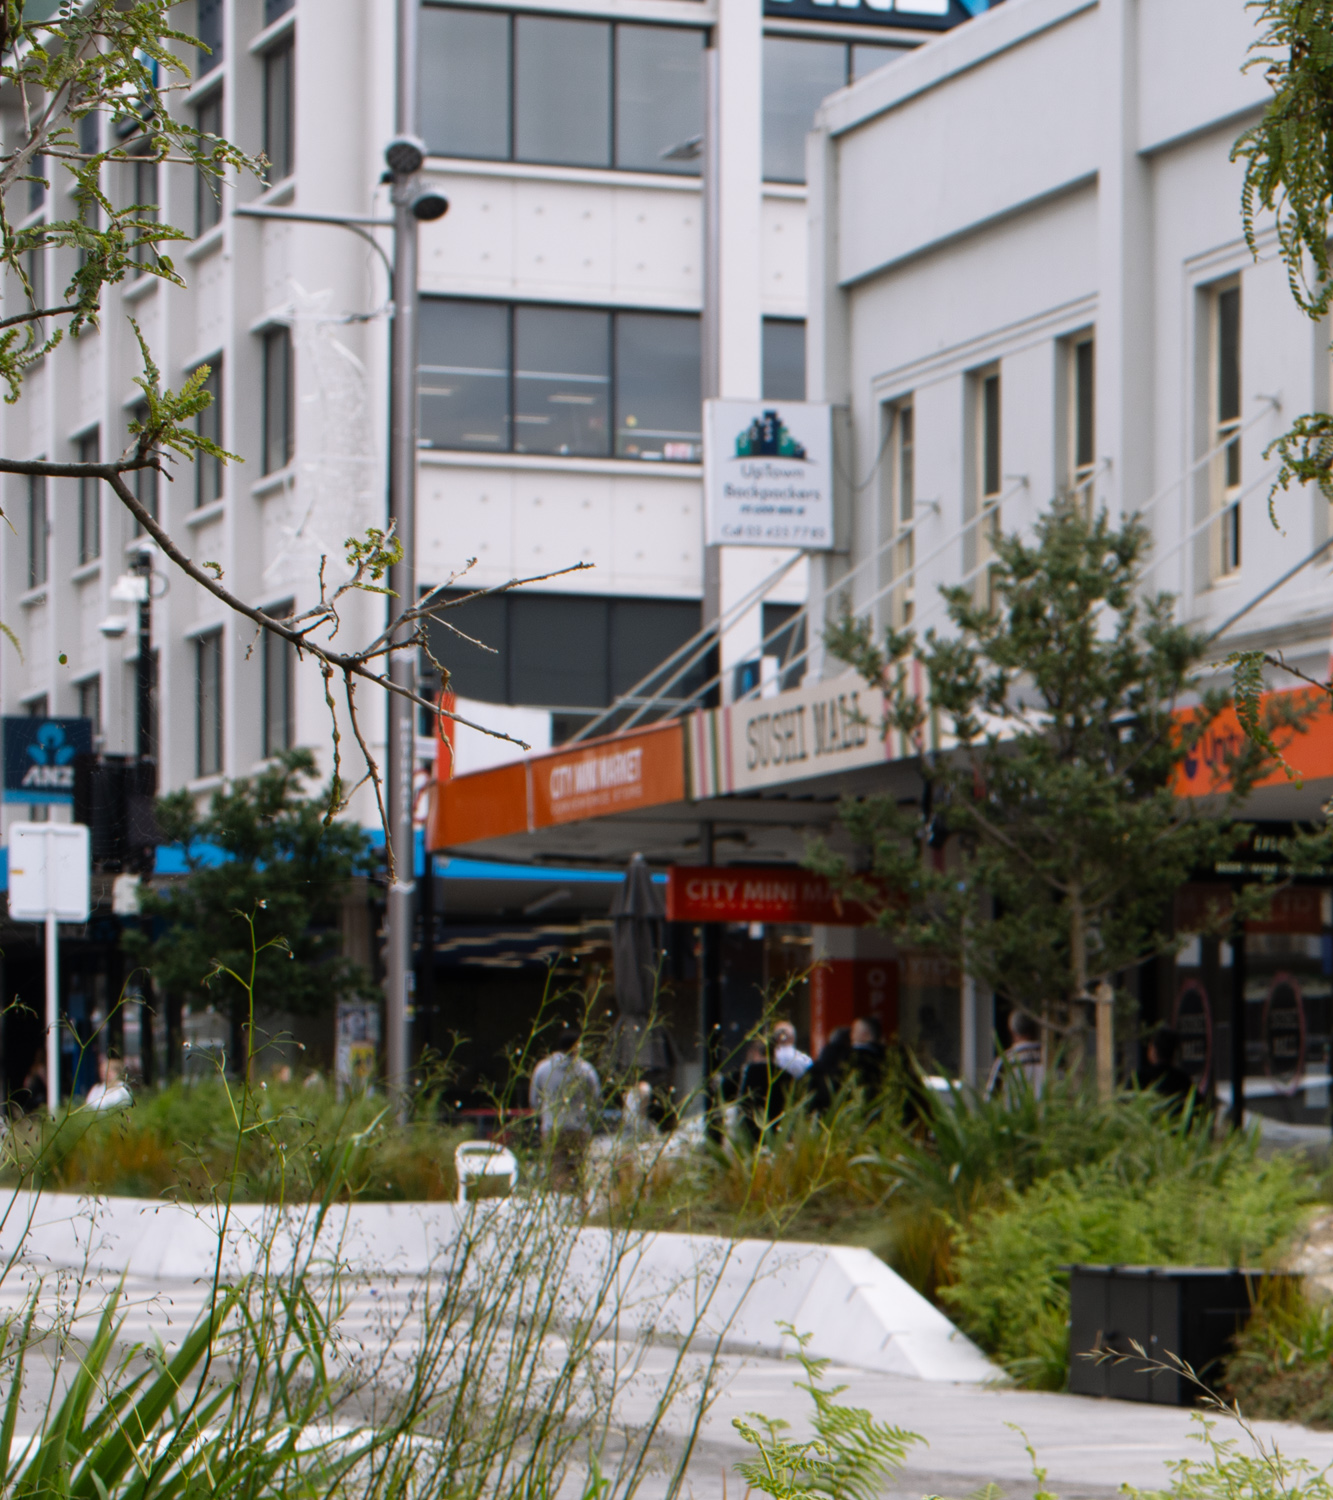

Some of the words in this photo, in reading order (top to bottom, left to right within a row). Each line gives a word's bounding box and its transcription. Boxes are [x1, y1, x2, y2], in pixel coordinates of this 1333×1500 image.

[745, 703, 809, 772] SUSHI
[21, 764, 75, 788] ANZ
[685, 877, 739, 902] CITY
[742, 879, 798, 903] MINI
